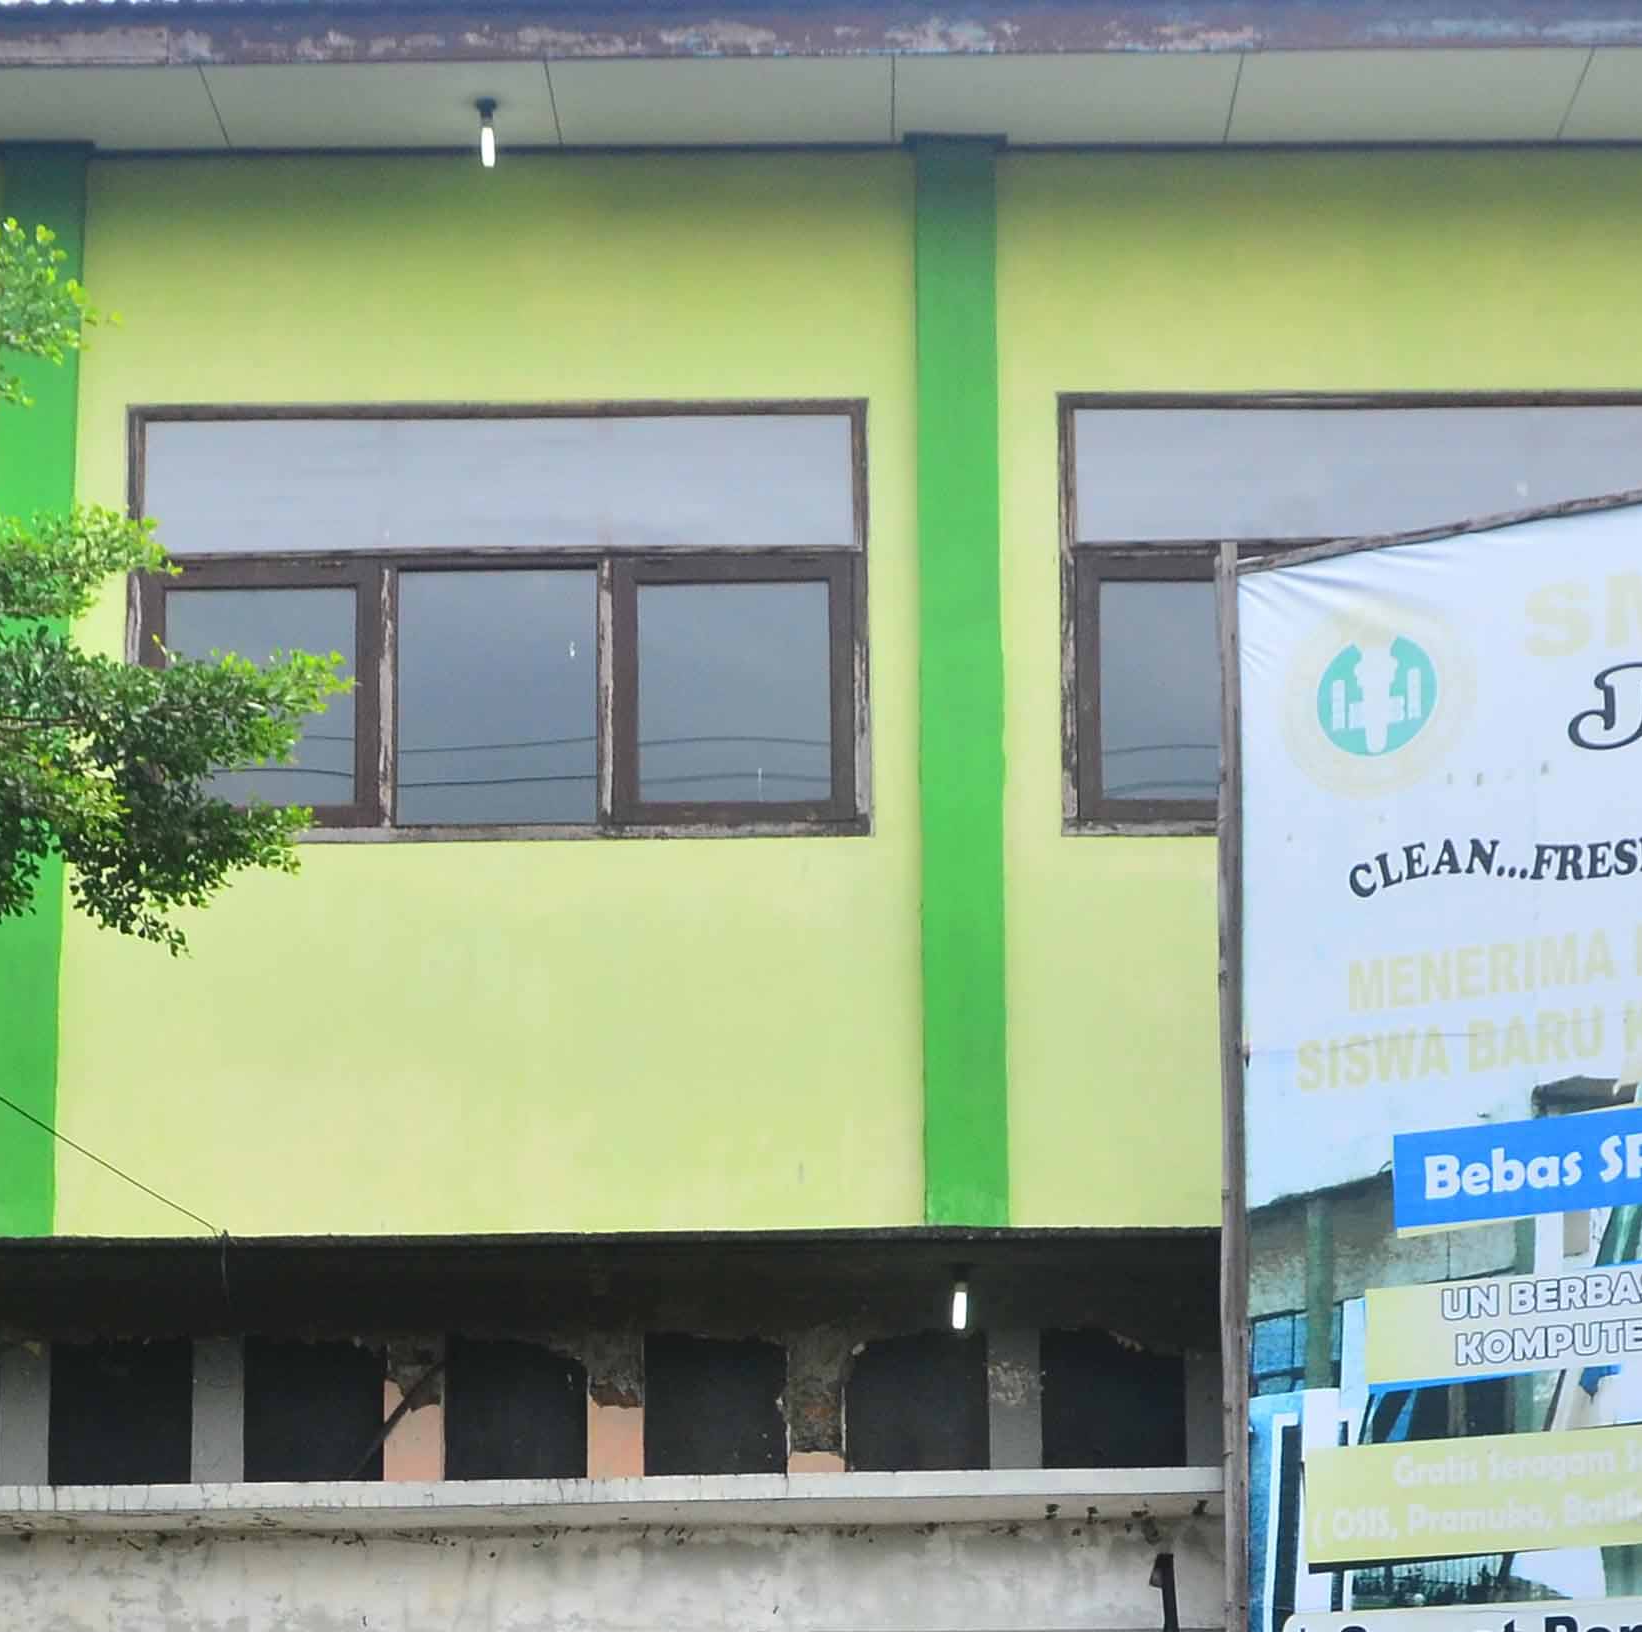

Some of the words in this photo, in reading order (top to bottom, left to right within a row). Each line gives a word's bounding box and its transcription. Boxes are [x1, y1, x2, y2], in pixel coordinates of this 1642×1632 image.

[1348, 927, 1616, 1013] MENERIMA
[1296, 1024, 1451, 1092] SISWA
[1467, 1006, 1605, 1073] BARU
[1423, 1152, 1582, 1201] Bebas
[1441, 1283, 1499, 1321] UN
[1391, 1453, 1478, 1490] Gratis
[1487, 1446, 1615, 1486] Seragam
